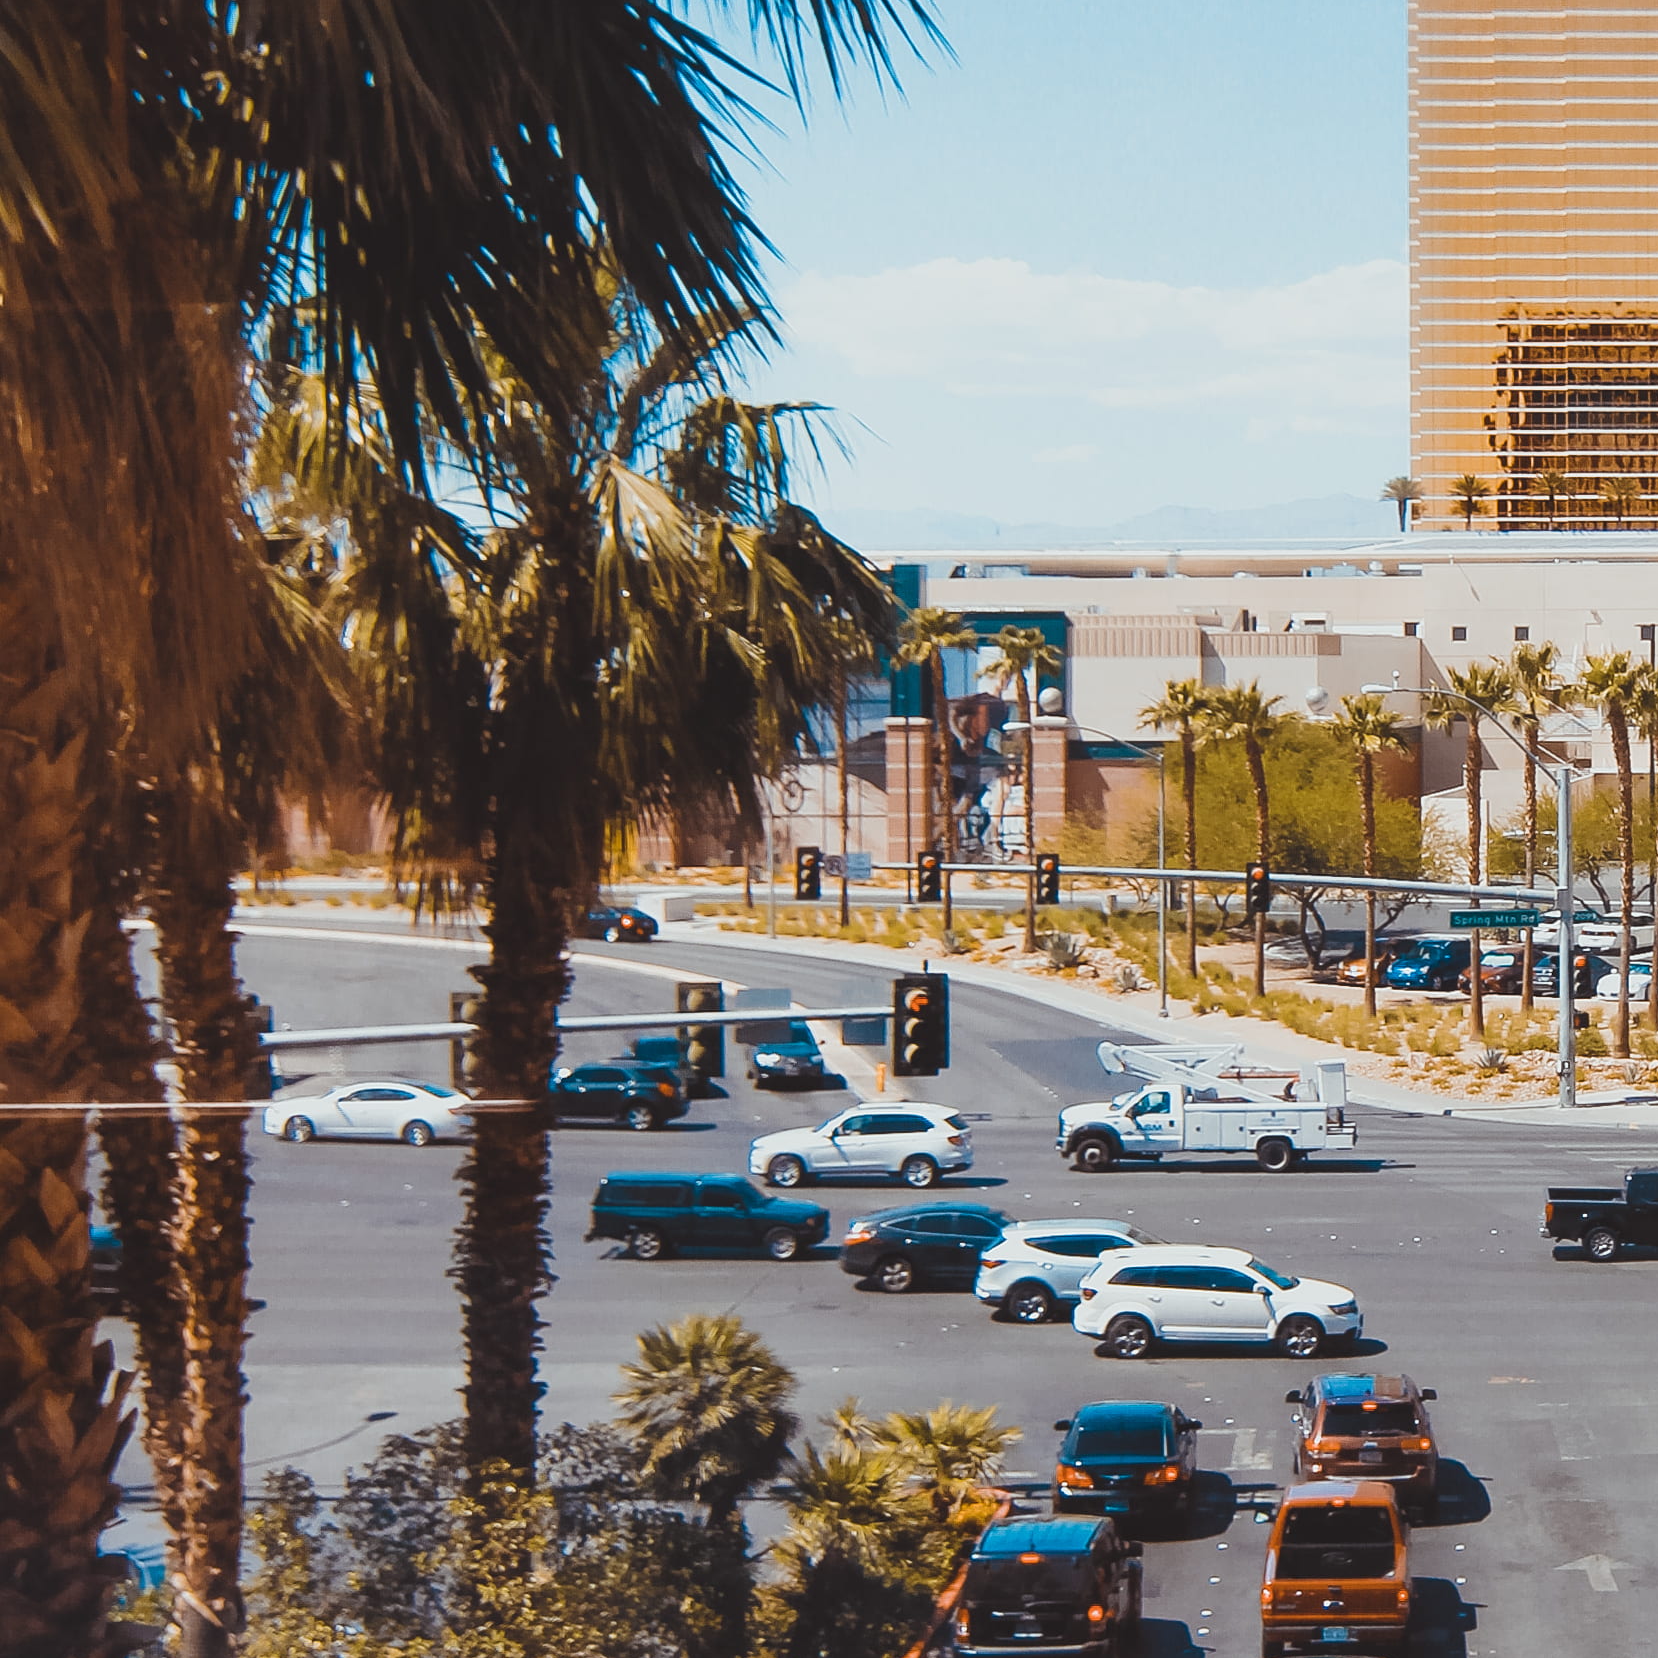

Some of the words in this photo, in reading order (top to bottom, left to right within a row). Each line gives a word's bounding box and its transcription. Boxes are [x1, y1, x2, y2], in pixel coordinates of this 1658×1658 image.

[1454, 915, 1491, 926] Spring
[1494, 914, 1517, 924] Mtn
[1520, 913, 1535, 923] Rd
